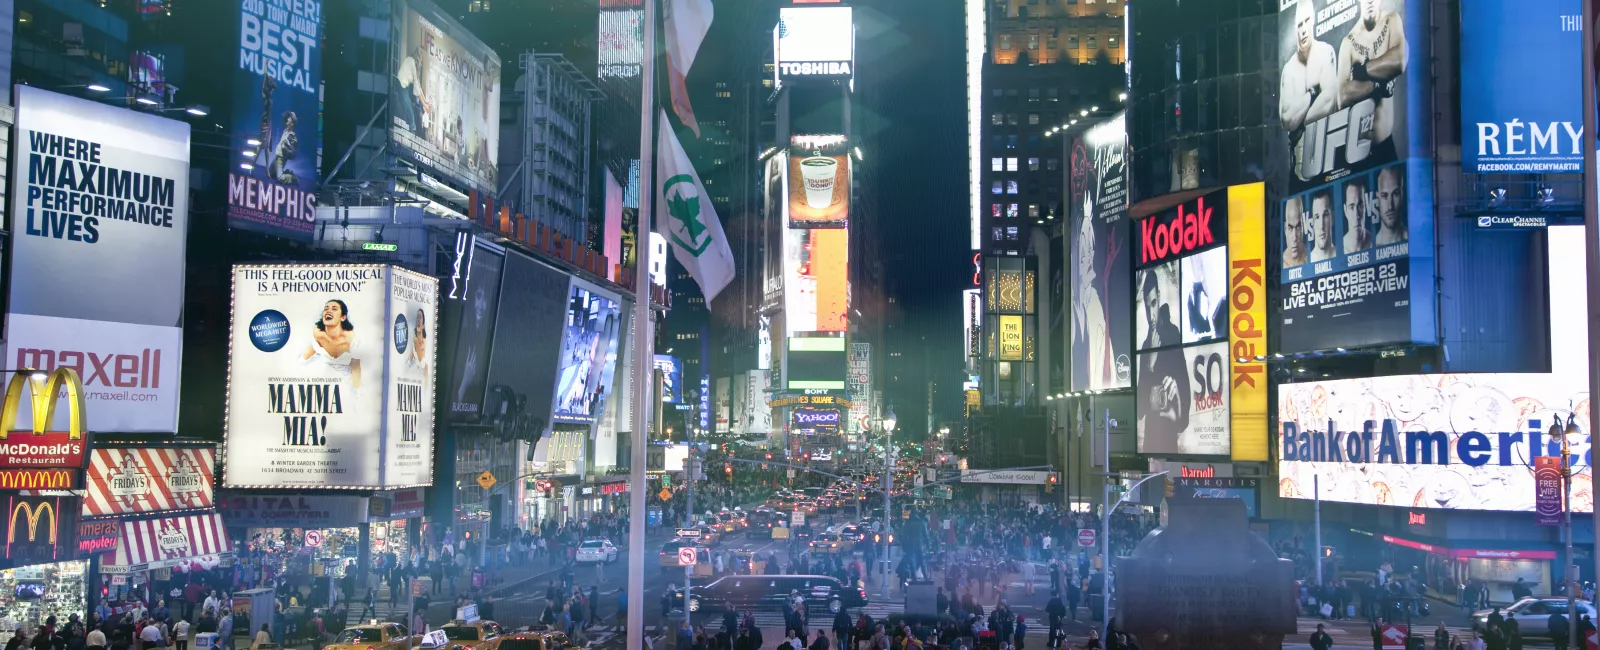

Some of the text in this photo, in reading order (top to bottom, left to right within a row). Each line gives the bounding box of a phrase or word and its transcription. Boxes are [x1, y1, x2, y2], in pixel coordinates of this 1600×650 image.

[267, 4, 288, 26] TONY
[290, 14, 317, 37] AWARD
[241, 12, 316, 71] BEST
[240, 48, 315, 93] MUSICAL
[780, 62, 851, 75] TOSHIBA
[1302, 98, 1374, 179] UFC
[1476, 118, 1584, 155] RÉMY
[29, 130, 101, 164] WHERE
[1478, 163, 1580, 171] FACEBOOK.COM/REMYMARTIN
[28, 153, 175, 208] MAXIMUM
[228, 172, 316, 222] MEMPHIS
[27, 185, 173, 228] PERFORMANCE
[26, 207, 100, 244] LIVES
[1142, 196, 1215, 264] Kodak
[366, 243, 393, 251] LAMAR
[1376, 245, 1409, 260] KAMPMANN
[1347, 252, 1369, 267] SHIELDS
[272, 269, 333, 281] FEEL-GOOD
[335, 267, 384, 283] MUSICAL
[1291, 263, 1397, 297] SAT. OCTOBER 23
[257, 281, 270, 293] IS
[271, 281, 280, 293] A
[1283, 294, 1306, 311] LIVE
[1308, 291, 1325, 306] ON
[251, 320, 288, 332] WORLDWIDE
[1005, 323, 1017, 331] THE
[1232, 258, 1264, 390] Kodak
[1002, 331, 1019, 343] LION
[1002, 343, 1020, 355] KING
[16, 347, 162, 389] maxell
[1193, 352, 1223, 400] SO
[267, 383, 343, 413] MAMMA
[396, 383, 422, 412] MAMMA
[811, 396, 835, 404] SQUARE
[1195, 391, 1223, 411] Kodak
[795, 412, 840, 424] YAHOO!
[282, 415, 327, 446] MIA!
[400, 413, 417, 442] MIA!
[0, 442, 80, 455] McDonald's
[1283, 418, 1592, 469] Bank of Americ
[9, 456, 65, 464] Restaurant
[989, 472, 1014, 482] Coming
[1016, 472, 1036, 481] soon!
[1181, 465, 1214, 478] Marriott
[113, 476, 145, 489] FRIDAY'S
[171, 475, 198, 487] FRIDAY'S
[1180, 479, 1256, 487] MARQUIS
[1539, 479, 1558, 488] FREE
[1541, 487, 1557, 496] WIFI
[162, 535, 184, 545] FRIDAY'S
